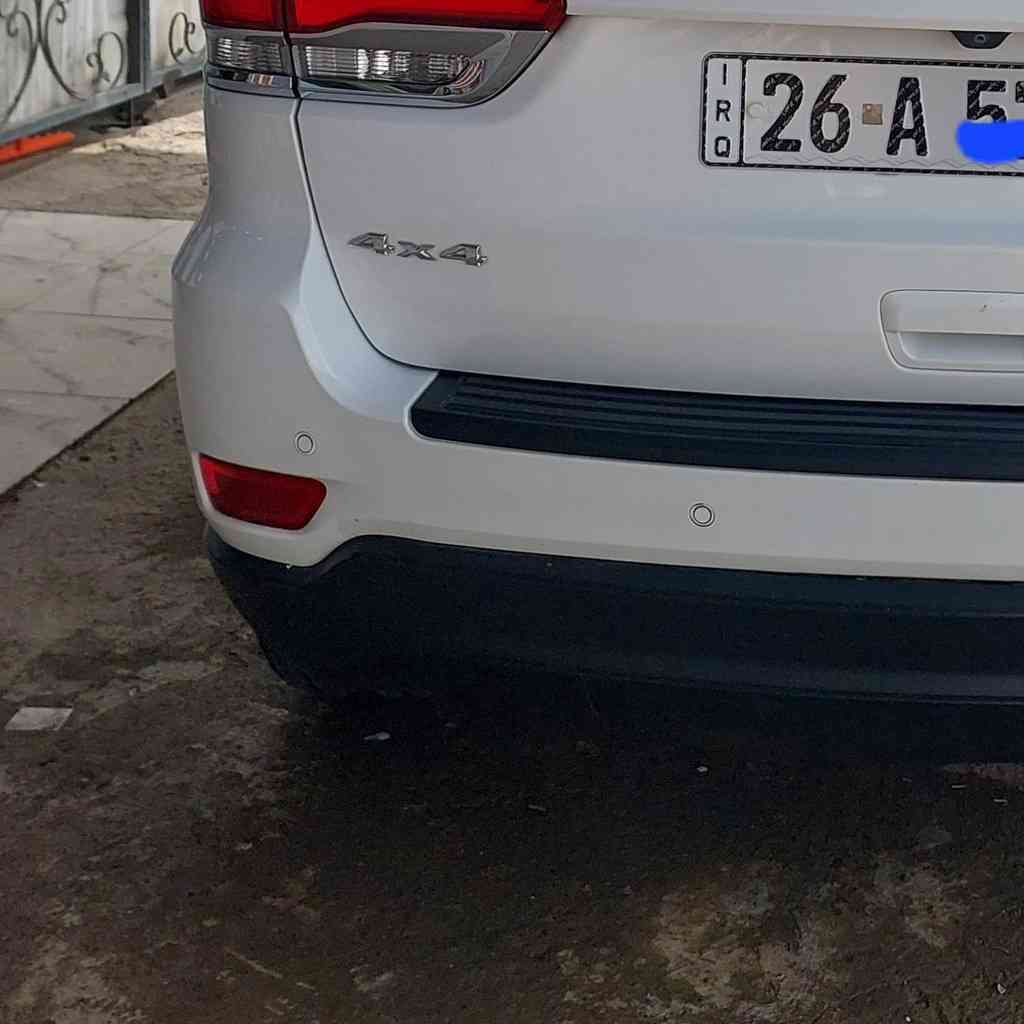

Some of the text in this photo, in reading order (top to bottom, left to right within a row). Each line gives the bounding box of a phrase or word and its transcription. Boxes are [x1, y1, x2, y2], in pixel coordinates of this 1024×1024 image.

[760, 72, 851, 154] 26
[886, 76, 928, 157] A
[349, 232, 488, 266] 4x4
